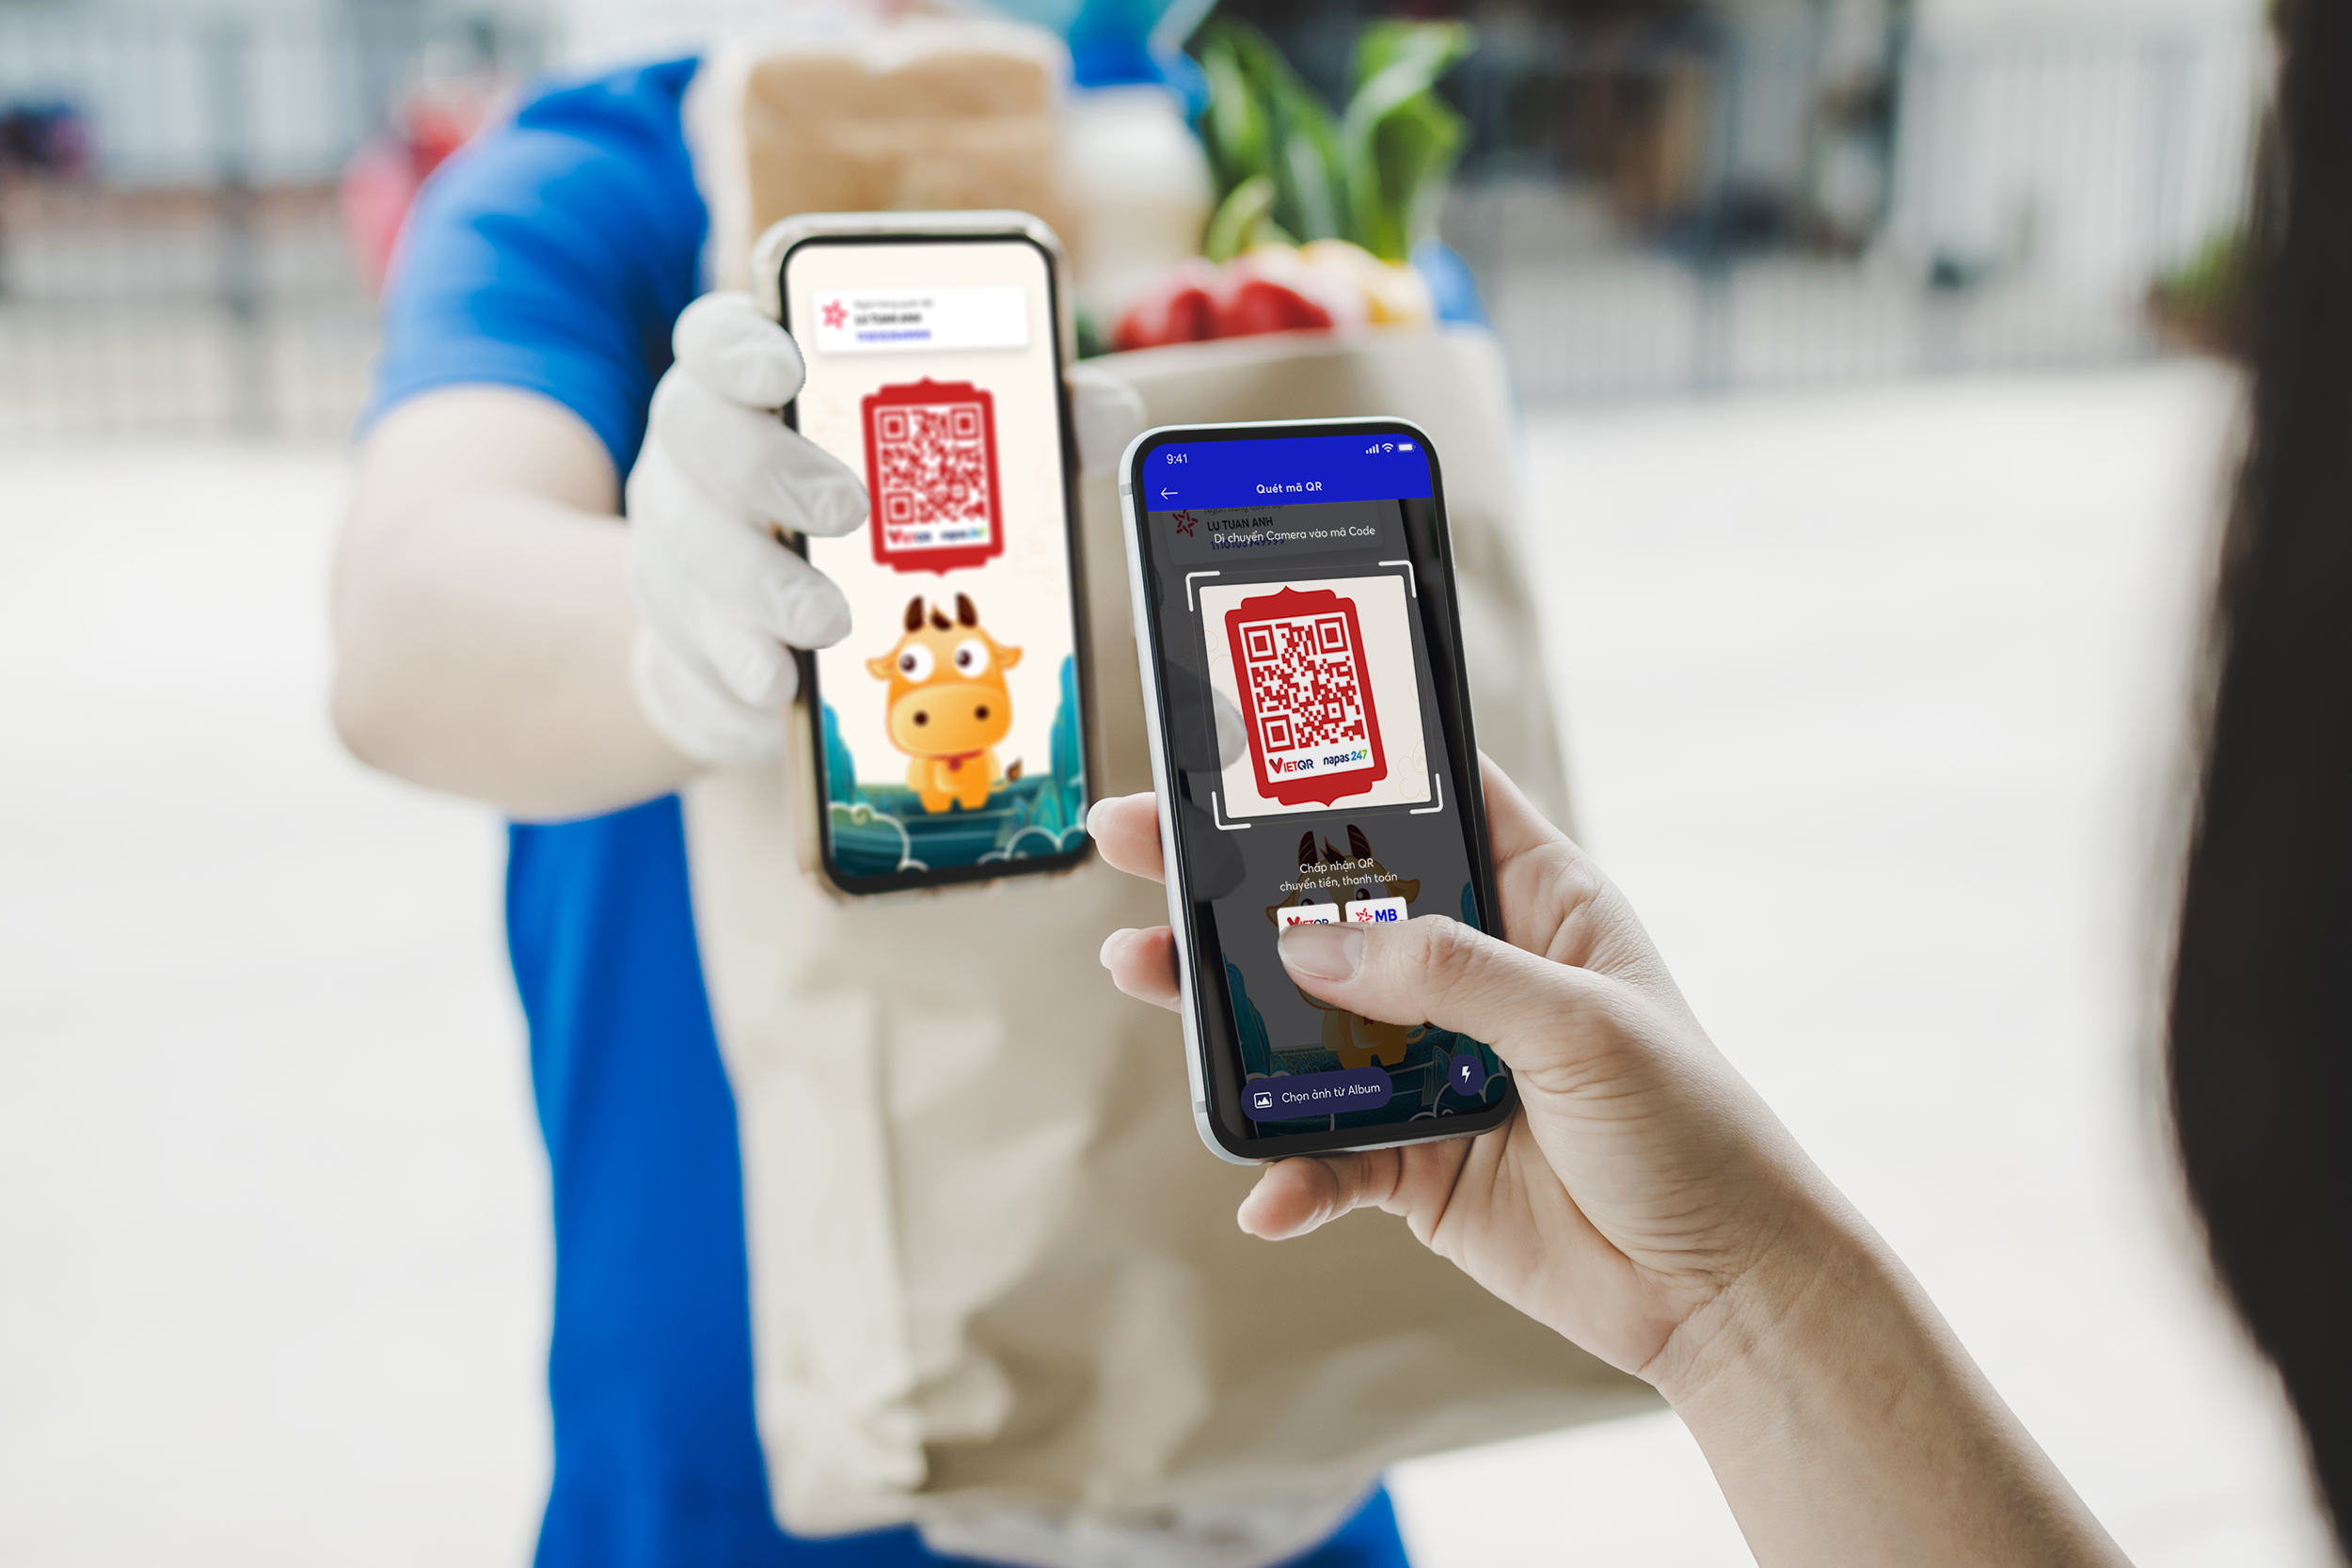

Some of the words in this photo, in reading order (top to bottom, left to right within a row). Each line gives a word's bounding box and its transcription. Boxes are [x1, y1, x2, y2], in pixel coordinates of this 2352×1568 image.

[1167, 453, 1188, 465] 9:41
[1256, 483, 1283, 494] Quét
[1286, 483, 1303, 492] mã
[1306, 481, 1323, 491] QR
[1207, 521, 1220, 531] LU
[1222, 518, 1249, 530] TUAN
[1252, 516, 1274, 528] ANH
[1215, 532, 1225, 544] Di
[1228, 530, 1263, 544] chuyển
[1266, 531, 1307, 541] Camera
[1309, 529, 1328, 539] vào
[1330, 527, 1346, 537] mã
[1348, 526, 1375, 536] Code
[1323, 753, 1350, 767] napas
[1351, 749, 1368, 761] 247
[1299, 862, 1327, 875] Chấp
[1330, 860, 1356, 873] nhận
[1358, 858, 1375, 869] QR
[1279, 878, 1316, 892] chuyển
[1343, 874, 1372, 886] thanh
[1375, 872, 1398, 883] toán
[1375, 909, 1398, 923] MB
[1281, 1092, 1310, 1104] Chọn
[1311, 1087, 1331, 1100] ảnh
[1334, 1086, 1345, 1098] từ
[1348, 1084, 1381, 1096] Album
